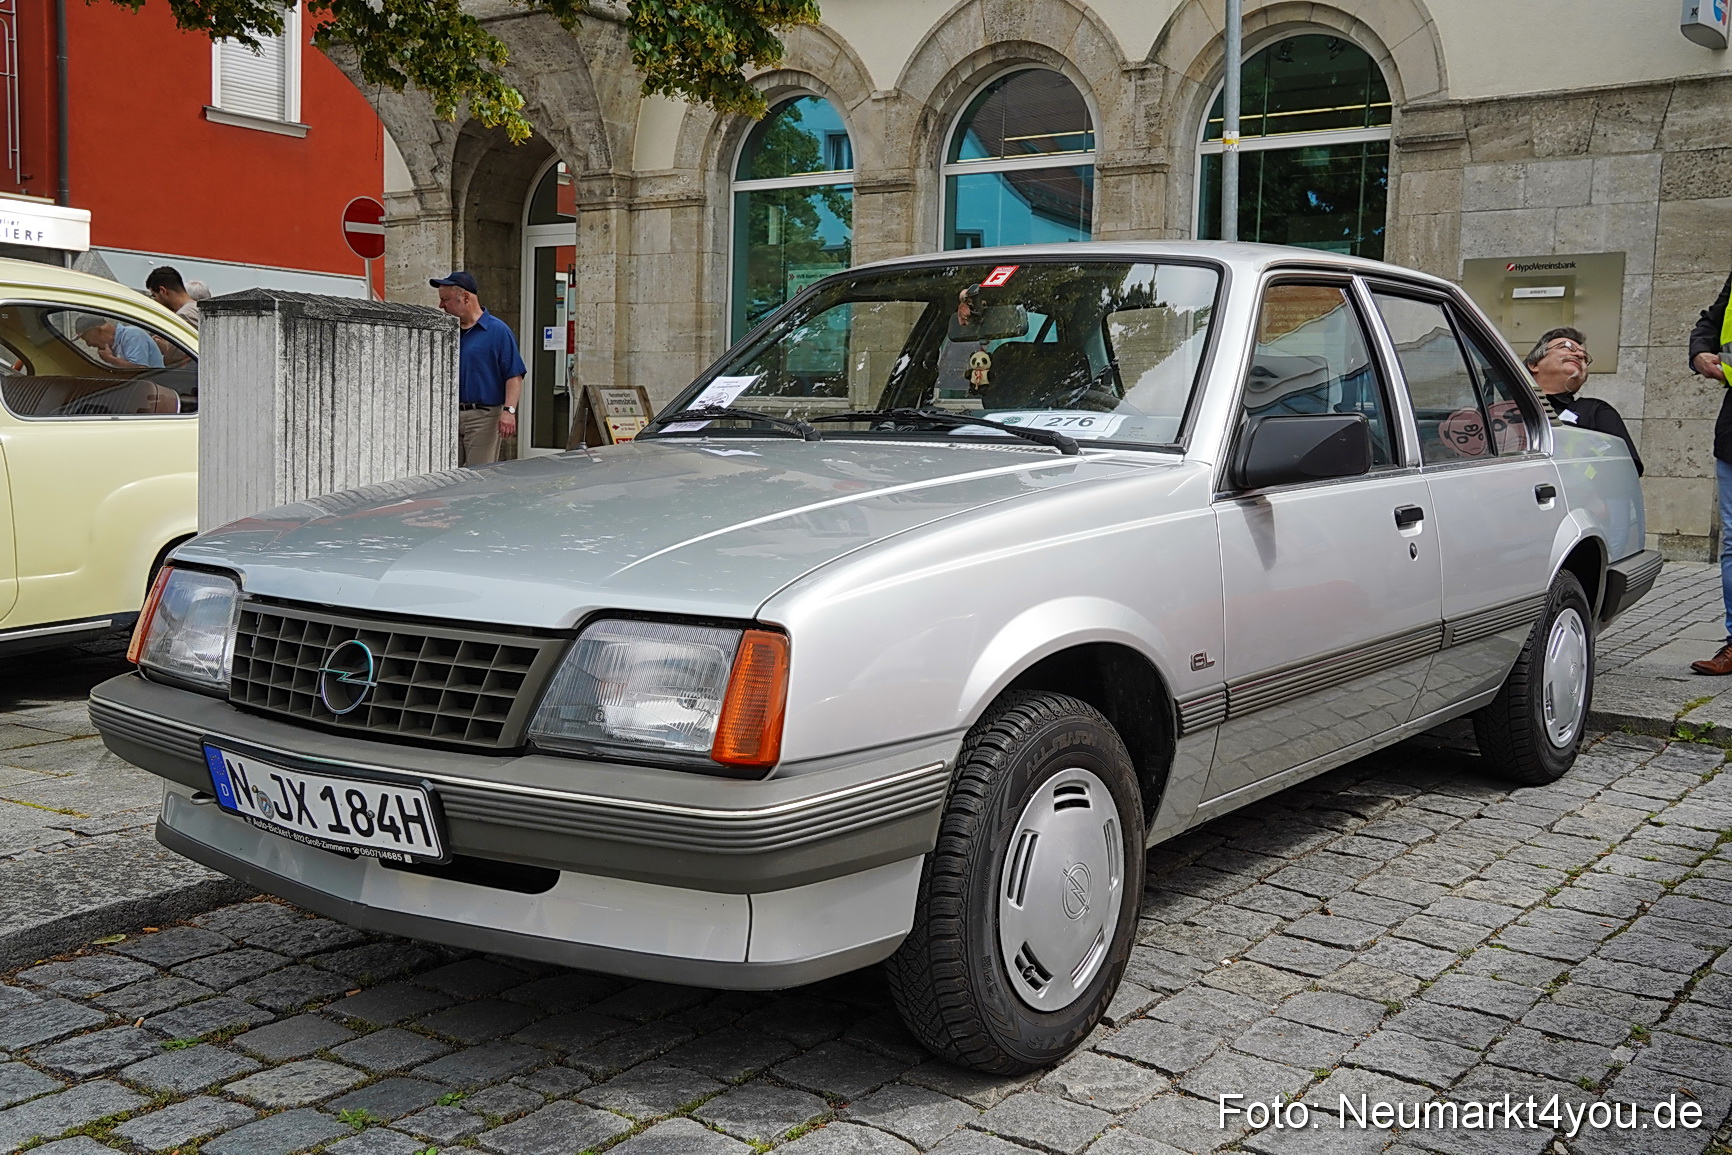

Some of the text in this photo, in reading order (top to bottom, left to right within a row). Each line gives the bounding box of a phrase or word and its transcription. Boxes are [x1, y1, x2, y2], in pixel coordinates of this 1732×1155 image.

[1515, 261, 1576, 272] HypoVereinsbank
[989, 272, 1007, 283] F
[1044, 416, 1096, 428] 276
[220, 783, 230, 797] D
[226, 758, 255, 809] N
[319, 785, 432, 847] 184H
